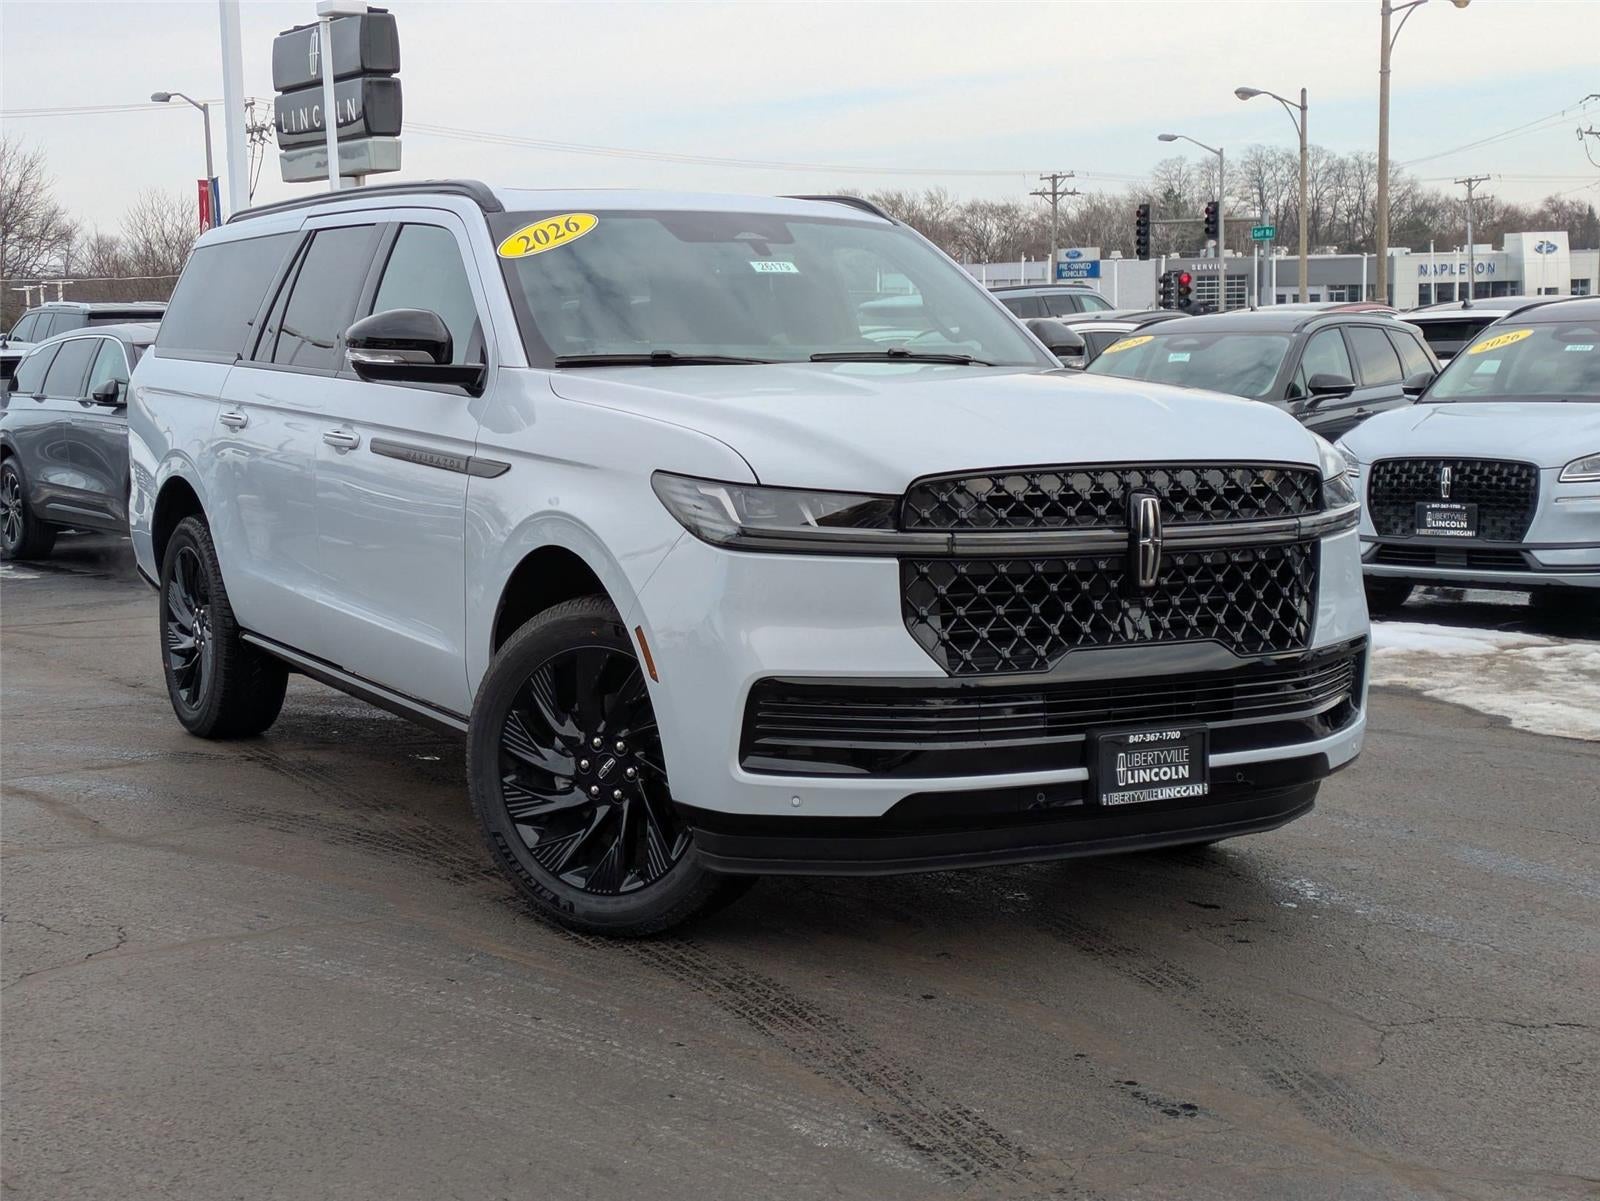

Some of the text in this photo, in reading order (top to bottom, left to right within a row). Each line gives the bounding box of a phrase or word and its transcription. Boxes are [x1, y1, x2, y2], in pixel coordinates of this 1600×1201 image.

[281, 98, 357, 133] LINCLN
[517, 217, 580, 253] 2026
[1059, 262, 1092, 270] PRE-OWNED
[1432, 520, 1468, 528] LINCOLN
[1128, 731, 1181, 743] 847-367-1700
[1127, 748, 1190, 767] LIBERTYVILLE
[1127, 765, 1190, 784] LINCOLN
